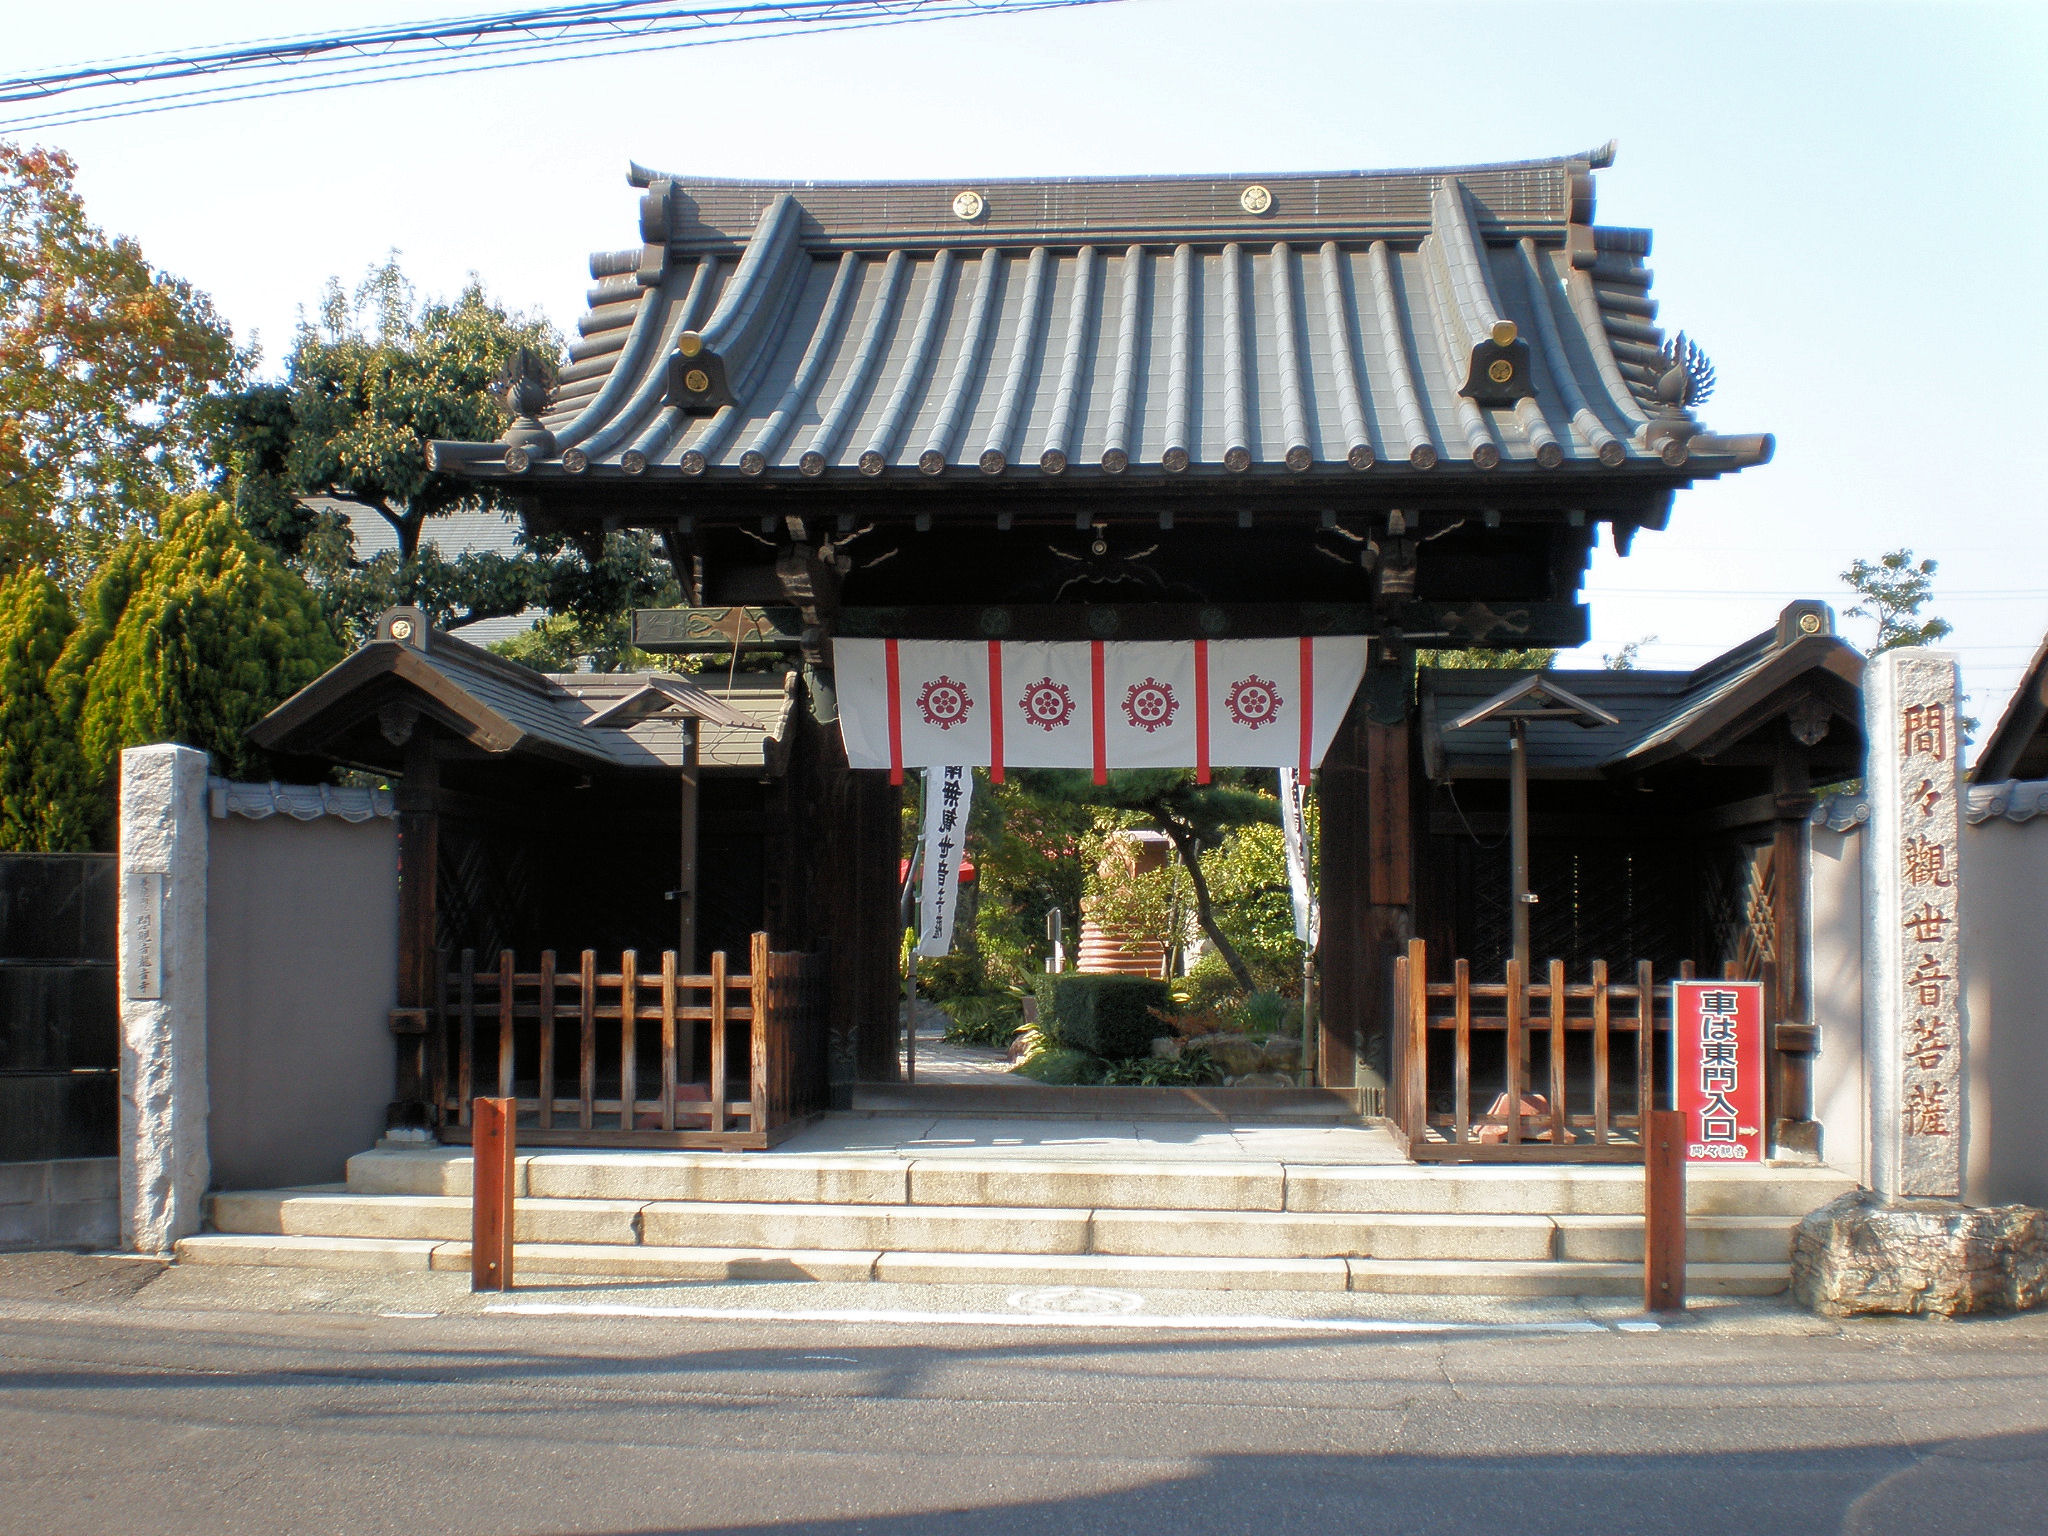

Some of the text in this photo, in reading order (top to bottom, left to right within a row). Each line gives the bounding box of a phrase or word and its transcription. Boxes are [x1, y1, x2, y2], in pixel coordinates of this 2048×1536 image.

[1701, 991, 1738, 1142] 車は東門入口
